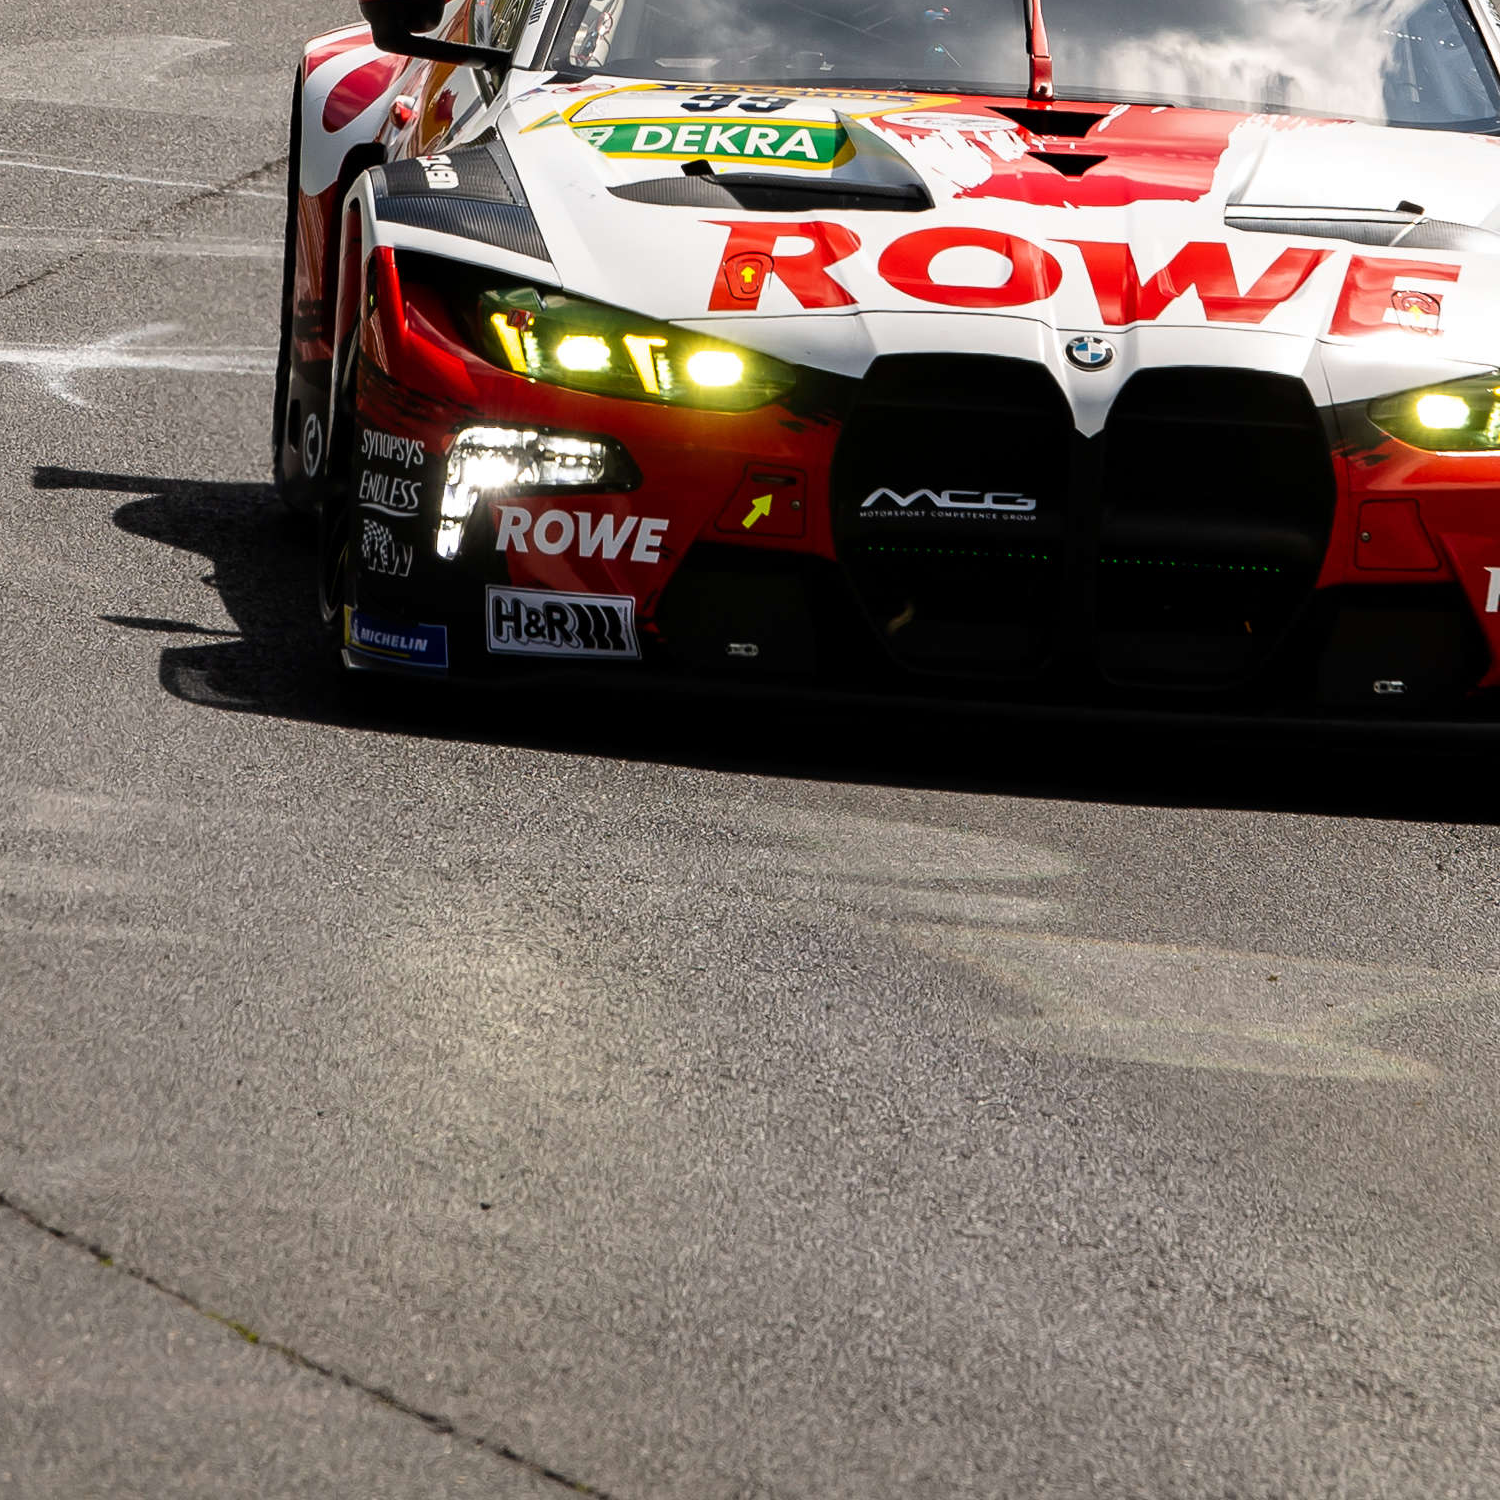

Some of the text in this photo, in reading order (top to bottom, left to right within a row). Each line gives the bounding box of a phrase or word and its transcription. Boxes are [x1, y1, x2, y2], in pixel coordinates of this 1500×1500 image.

[630, 125, 820, 160] DEKRA
[698, 219, 1463, 338] ROWE
[358, 469, 422, 510] ENDLESS
[494, 504, 670, 564] ROWE
[360, 626, 428, 652] MICHELIN
